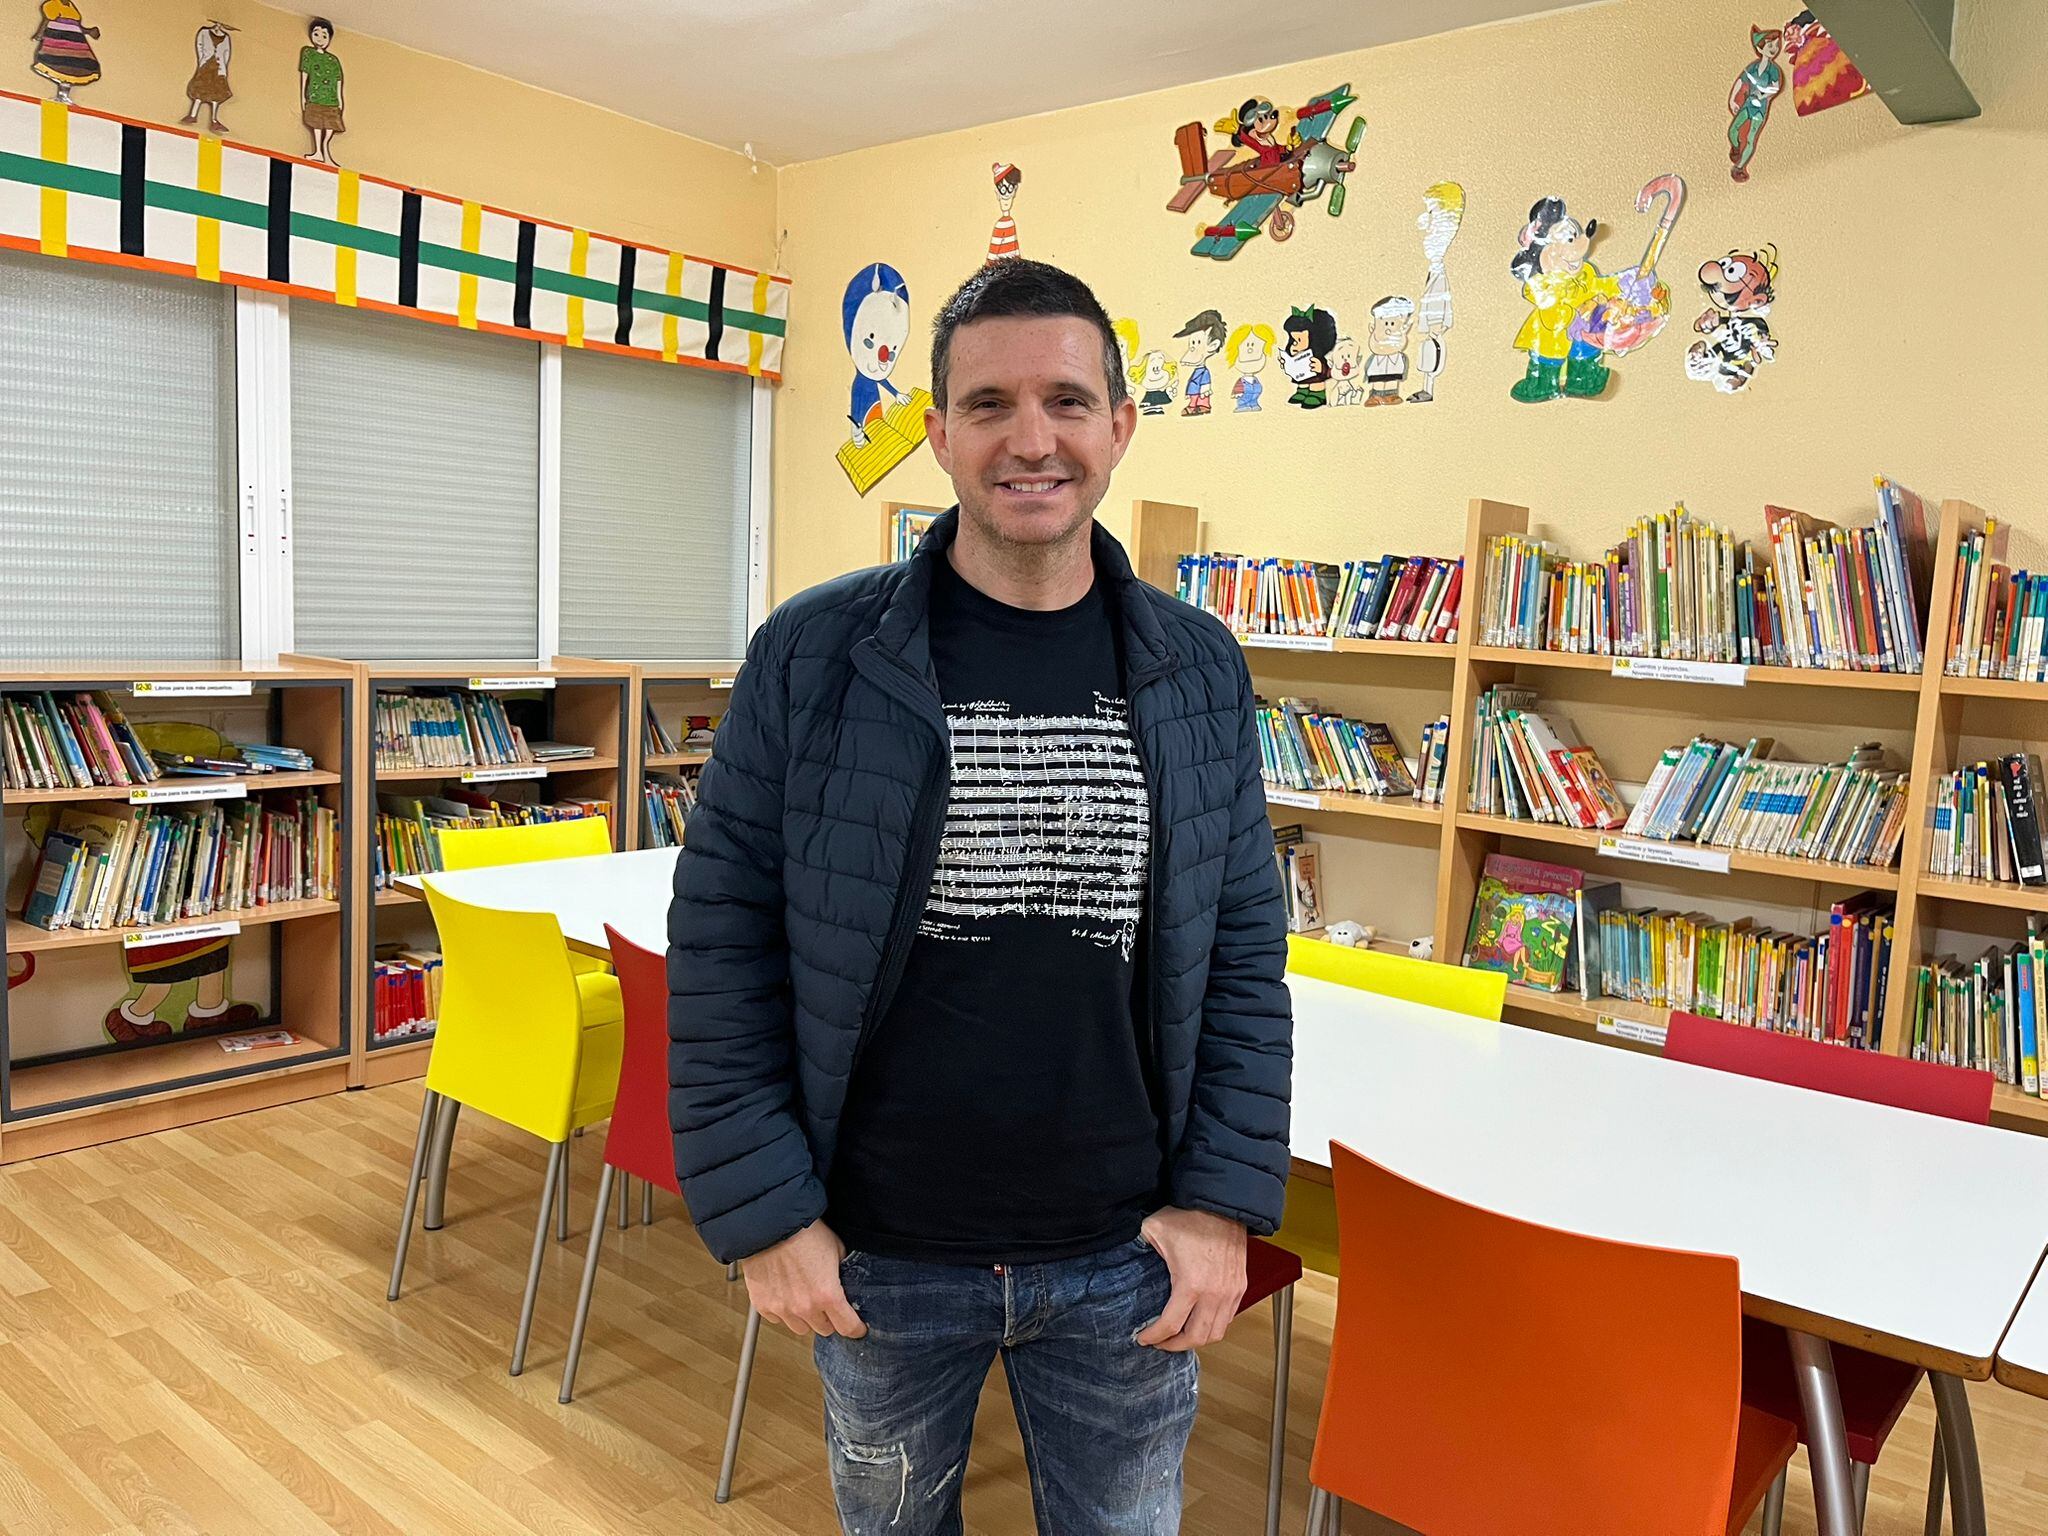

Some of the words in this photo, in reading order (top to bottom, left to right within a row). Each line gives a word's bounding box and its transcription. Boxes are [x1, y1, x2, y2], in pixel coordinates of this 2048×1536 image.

[1618, 842, 1642, 851] Cuentos
[1616, 1022, 1639, 1031] Cuentos
[1615, 1028, 1638, 1038] Novelas
